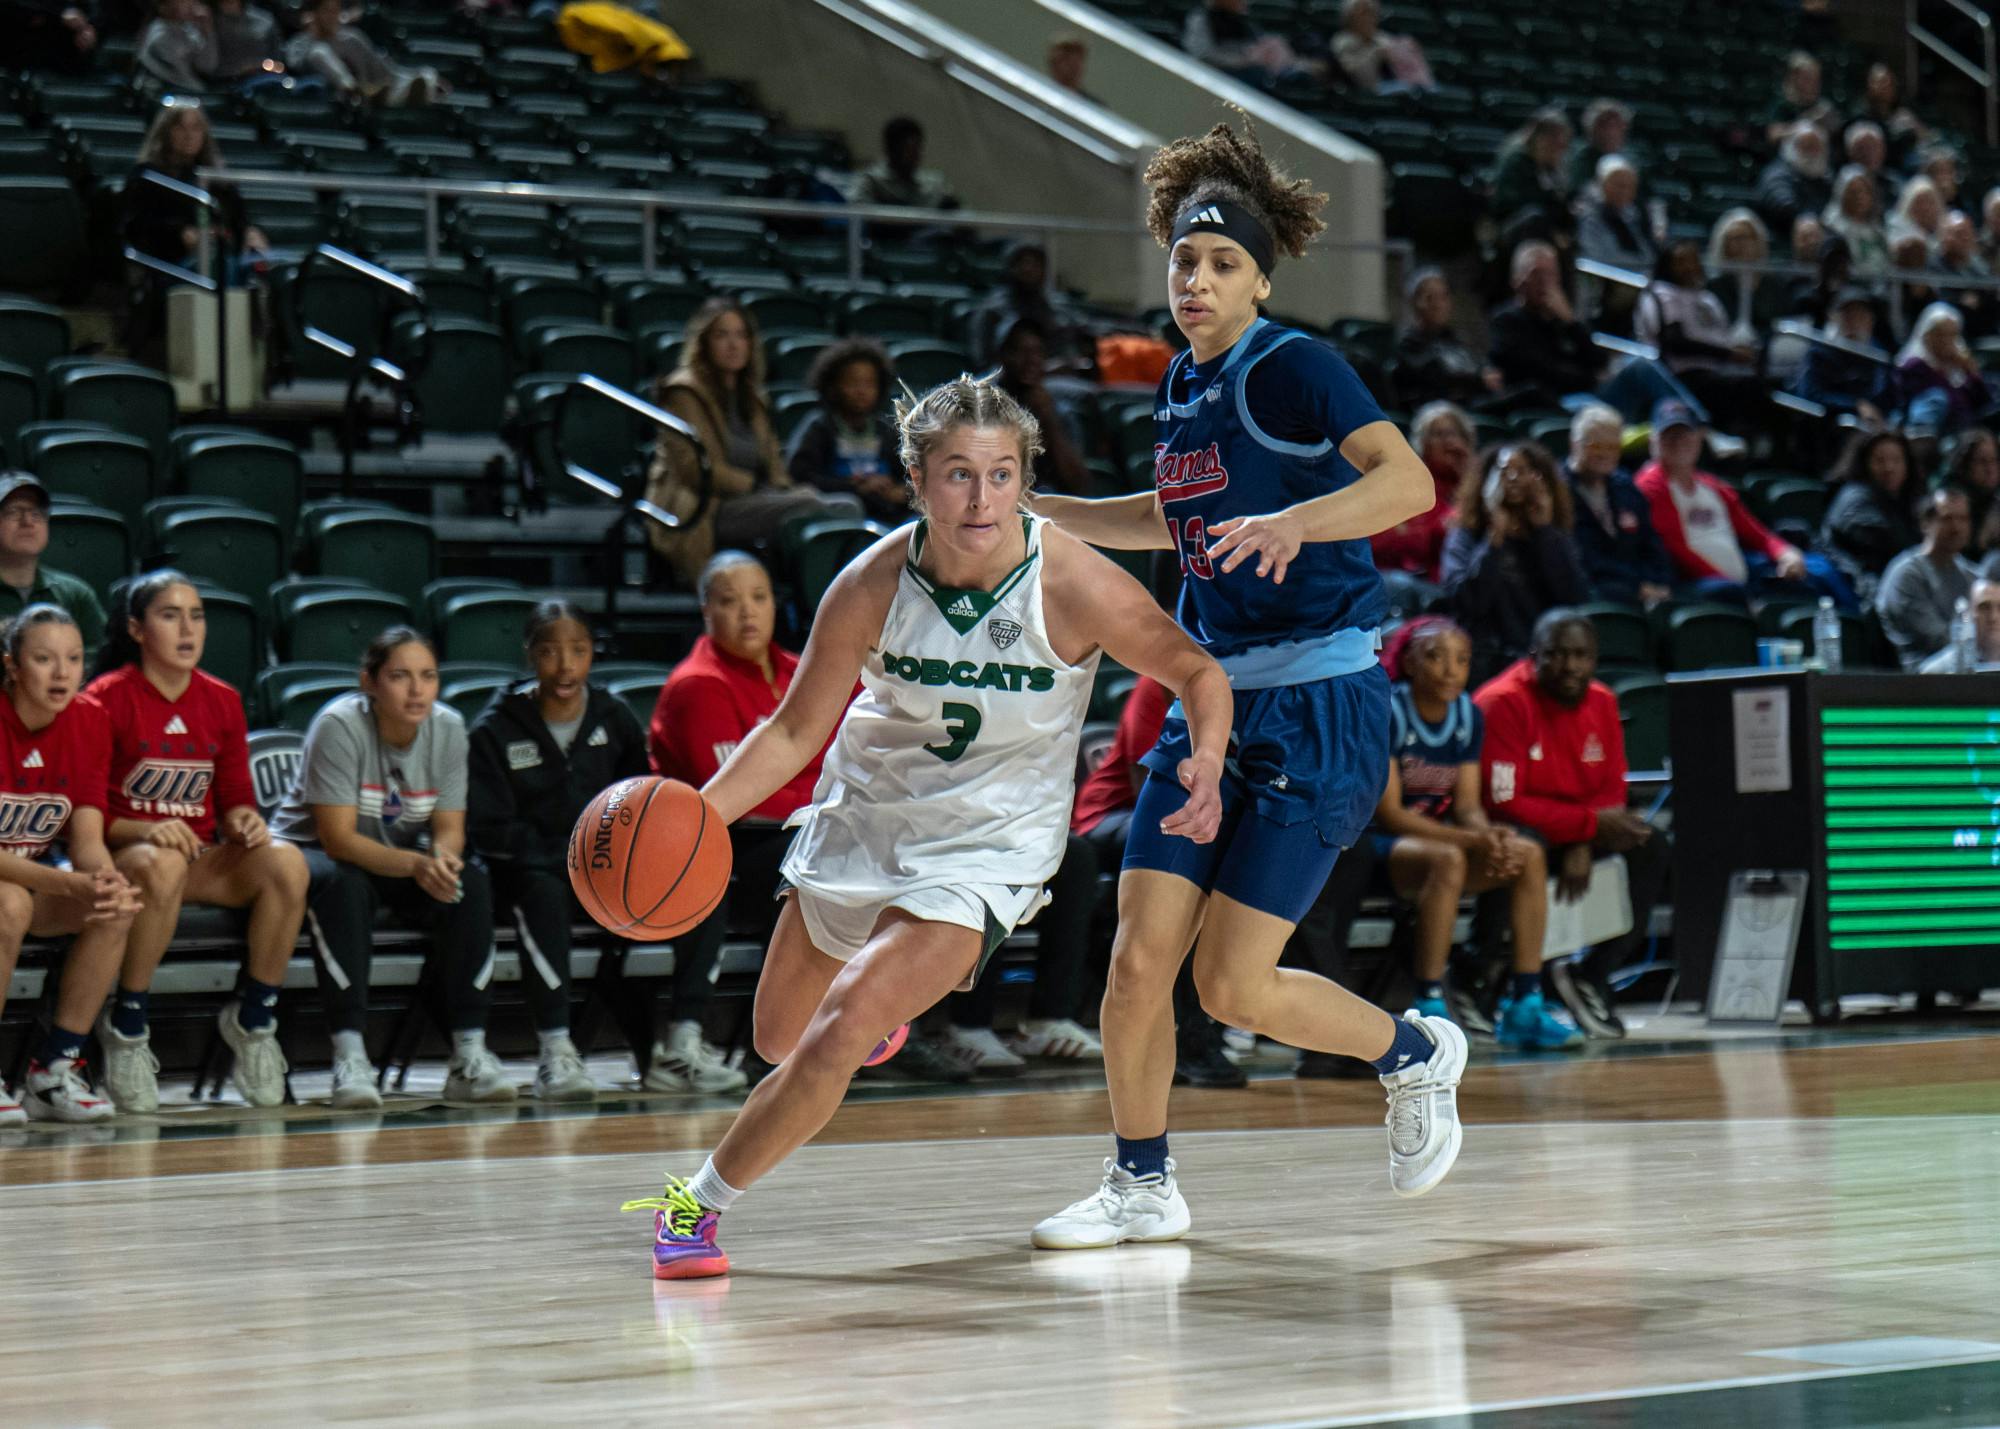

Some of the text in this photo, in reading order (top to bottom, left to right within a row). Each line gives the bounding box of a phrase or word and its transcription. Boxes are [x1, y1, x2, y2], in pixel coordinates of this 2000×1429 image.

[947, 607, 979, 618] adidas
[923, 701, 982, 762] 3
[125, 763, 214, 803] UIC
[254, 752, 303, 800] OH
[0, 796, 69, 840] UC
[591, 779, 644, 869] ALDING
